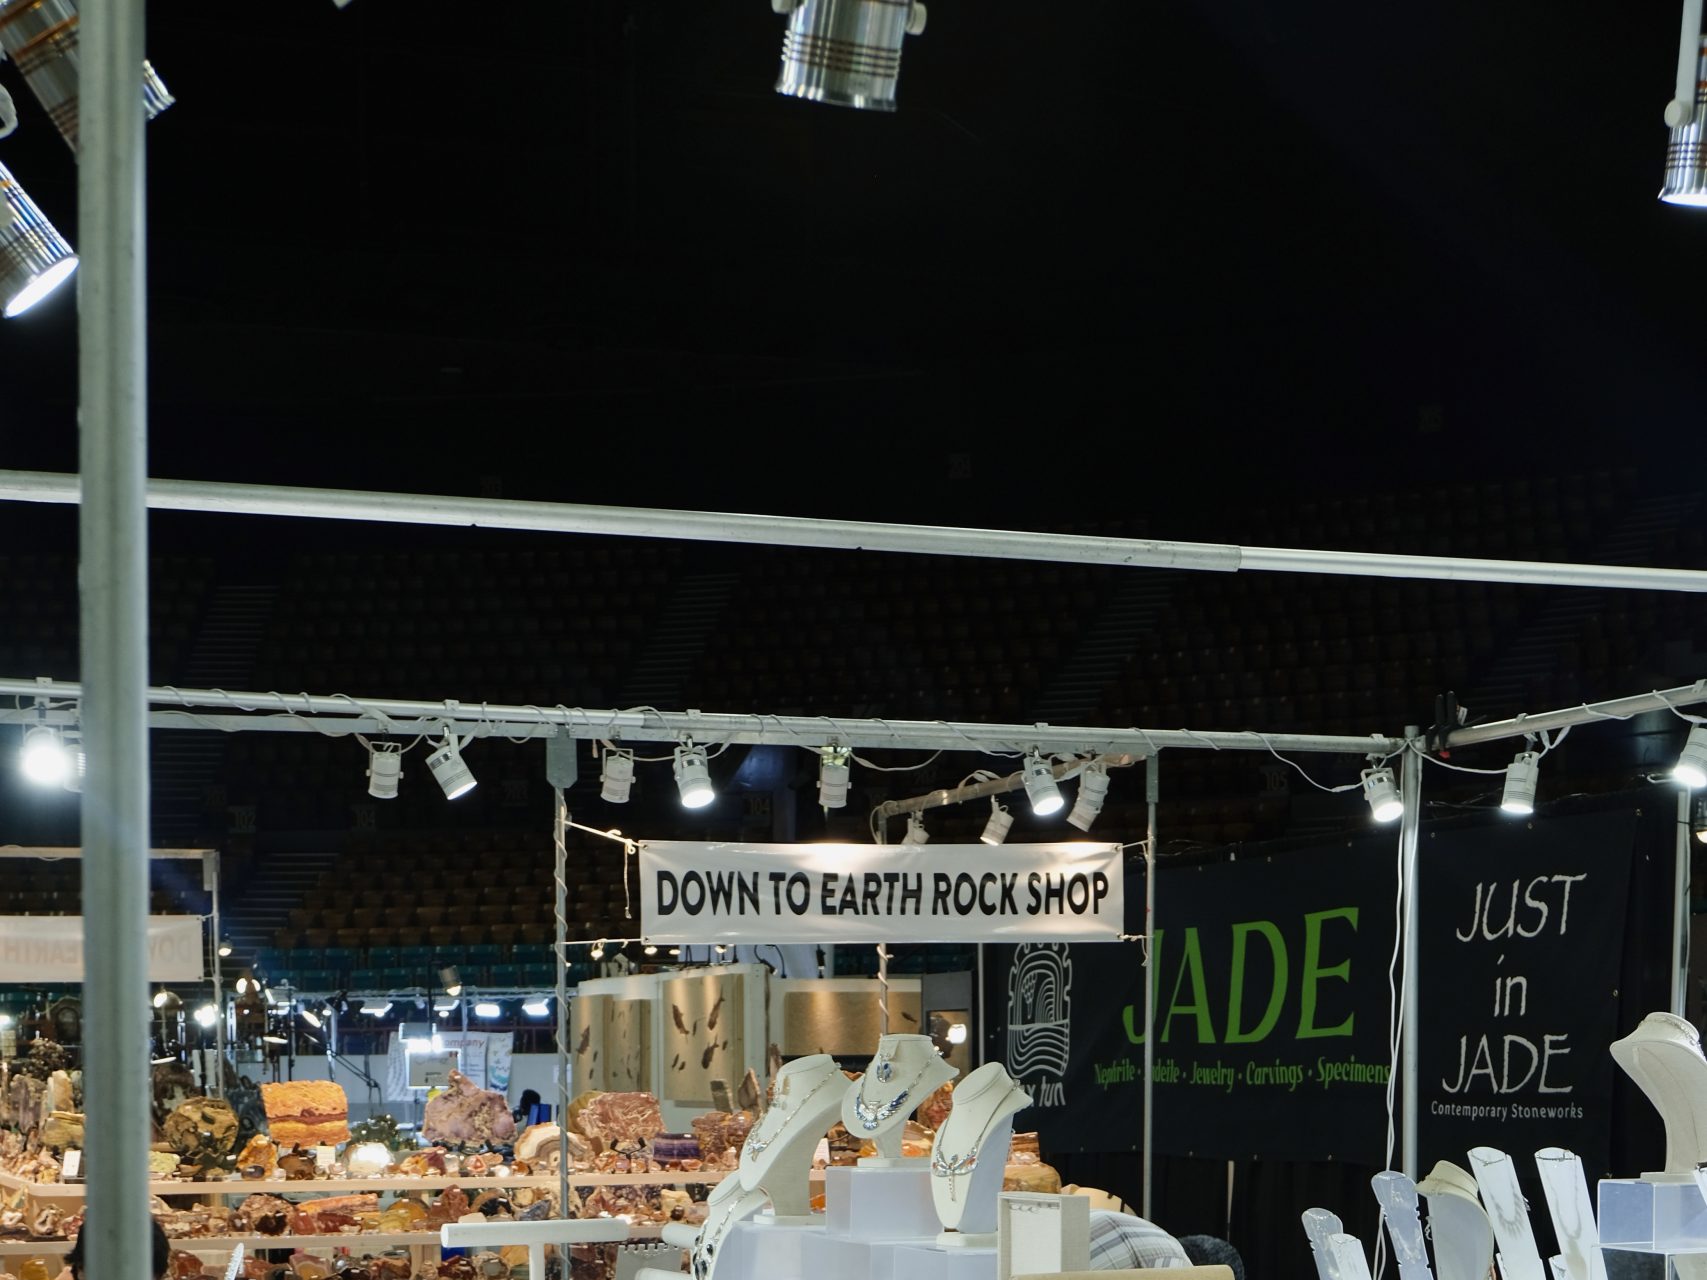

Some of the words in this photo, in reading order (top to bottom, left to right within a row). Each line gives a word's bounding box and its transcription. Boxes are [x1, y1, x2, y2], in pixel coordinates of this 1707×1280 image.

[657, 870, 760, 916] DOWN
[769, 871, 810, 916] TO
[821, 872, 922, 916] EARTH
[931, 872, 1019, 916] ROCK
[1027, 872, 1109, 916] SHOP
[1456, 873, 1587, 942] JUST
[1122, 906, 1359, 1045] JADE
[1493, 954, 1527, 1018] in
[441, 1037, 485, 1050] ompany
[1442, 1033, 1573, 1095] JADE
[1094, 1057, 1135, 1091] Nephrite
[1144, 1058, 1180, 1084] adeite
[1189, 1059, 1234, 1093] Jewelry
[1246, 1058, 1303, 1092] Carvings
[1316, 1053, 1392, 1091] Specimens
[1431, 1100, 1507, 1122] Contemporary
[1511, 1102, 1583, 1119] Stoneworks
